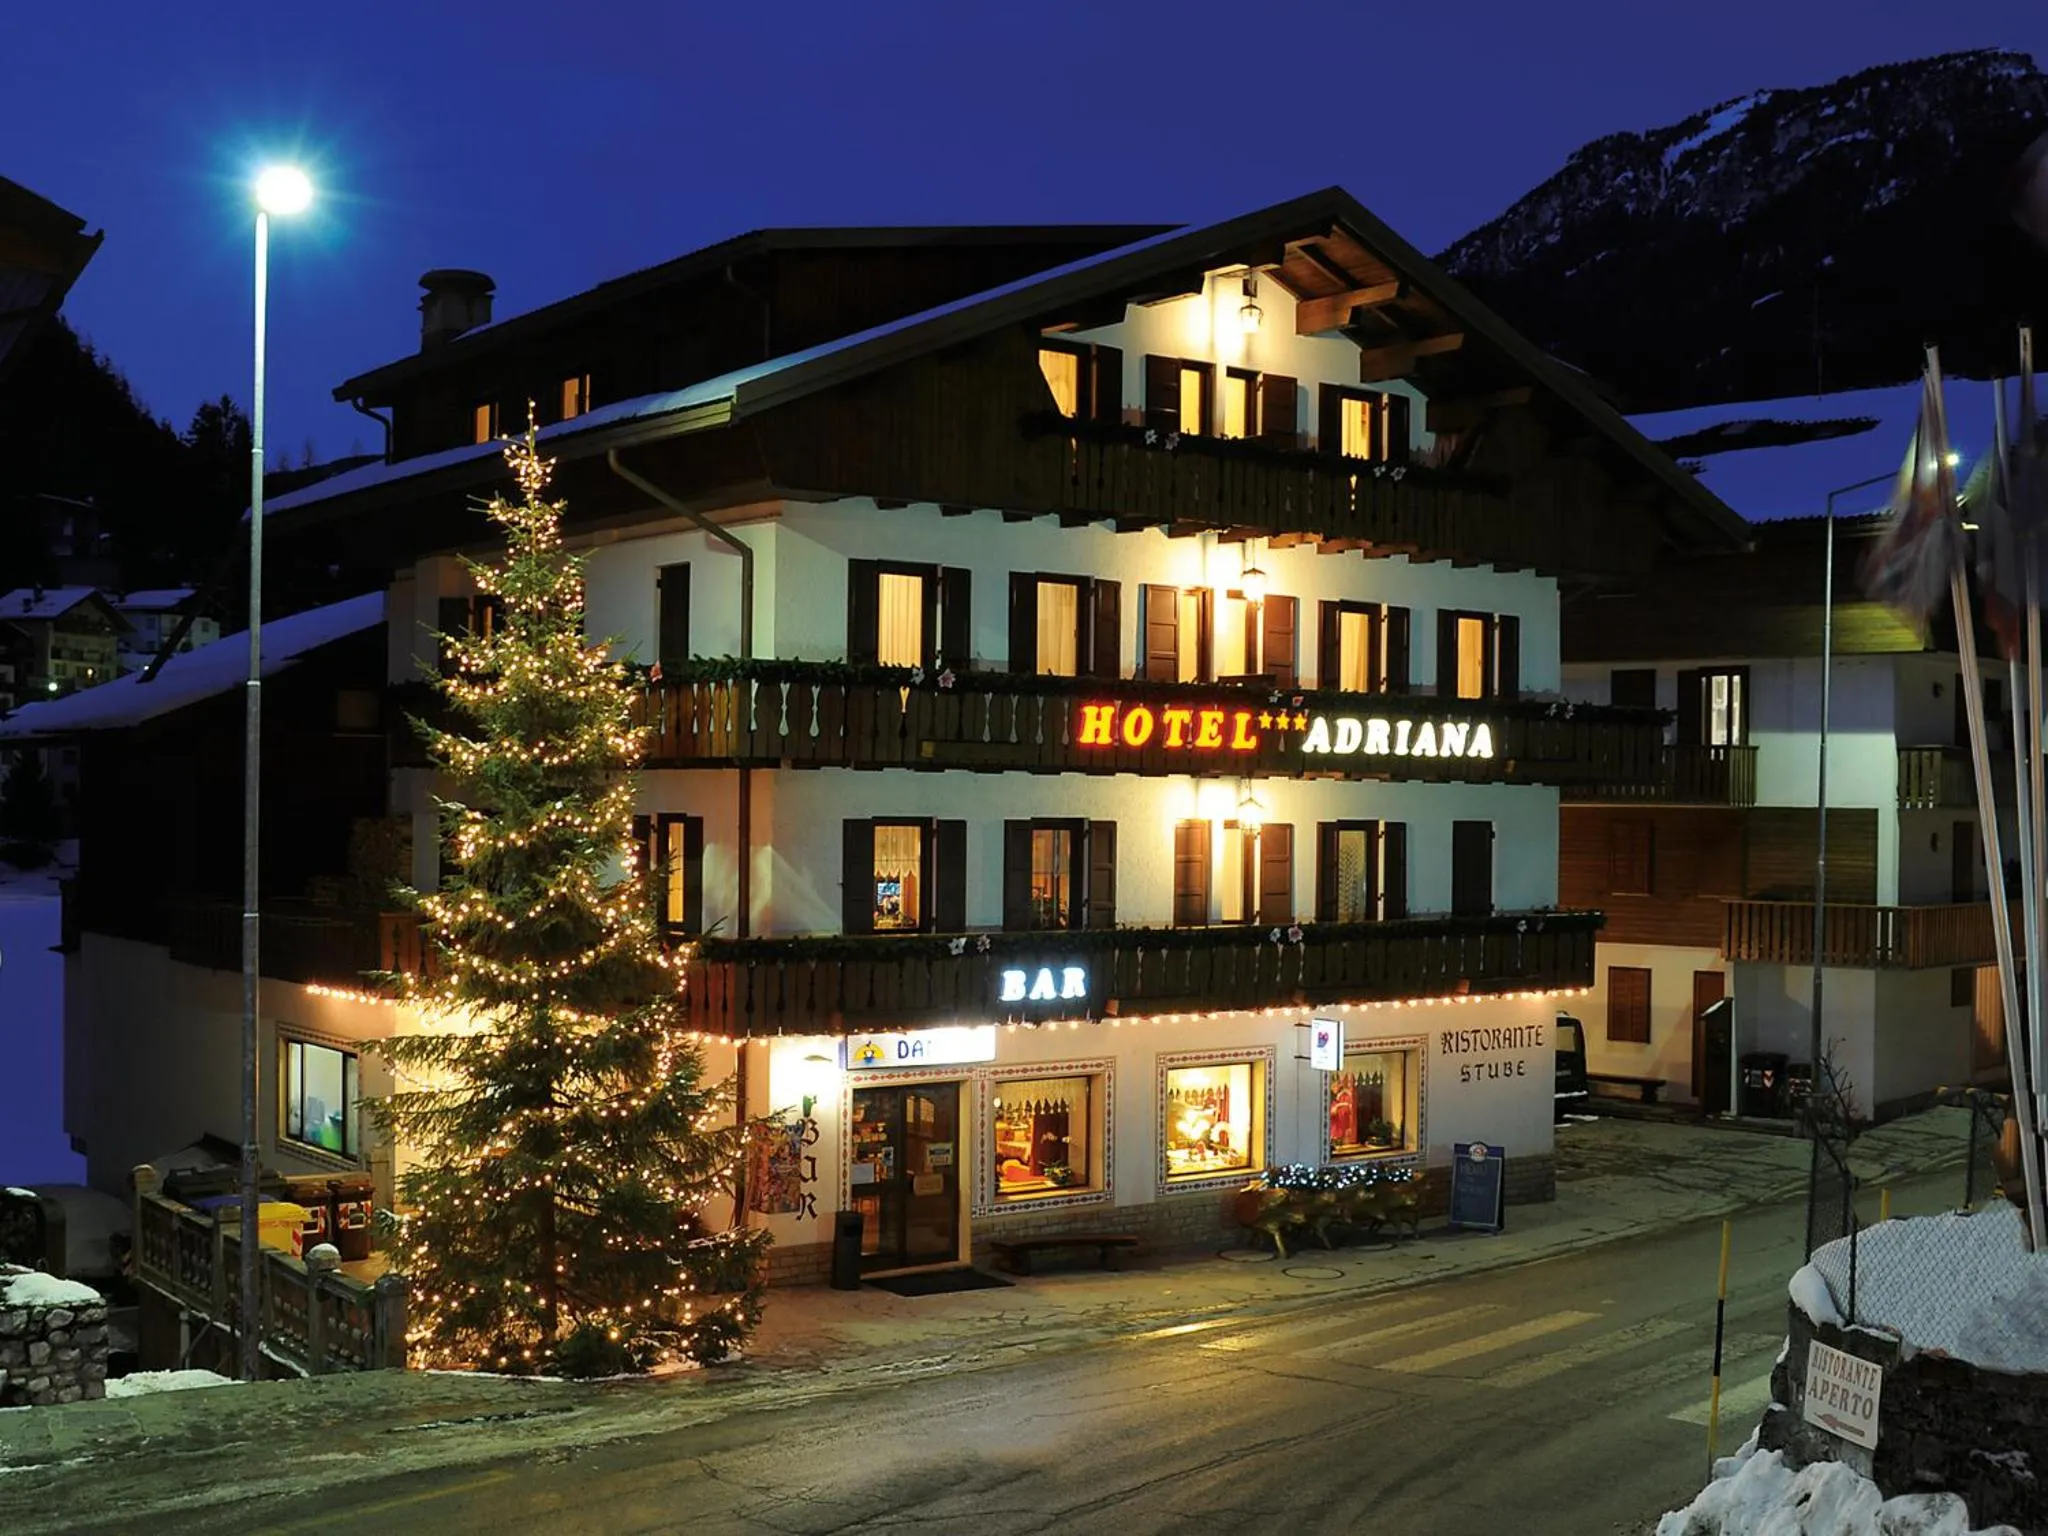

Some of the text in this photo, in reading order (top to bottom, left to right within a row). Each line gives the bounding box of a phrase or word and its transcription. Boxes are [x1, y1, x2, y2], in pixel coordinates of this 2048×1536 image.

[1079, 705, 1494, 758] HOTEL ADRIANA
[999, 966, 1087, 1001] BAR
[1440, 1024, 1545, 1055] RISTORANTE
[1460, 1060, 1526, 1083] STUBE
[1811, 1346, 1878, 1391] RISTORANTE
[1807, 1375, 1874, 1421] APERTO
